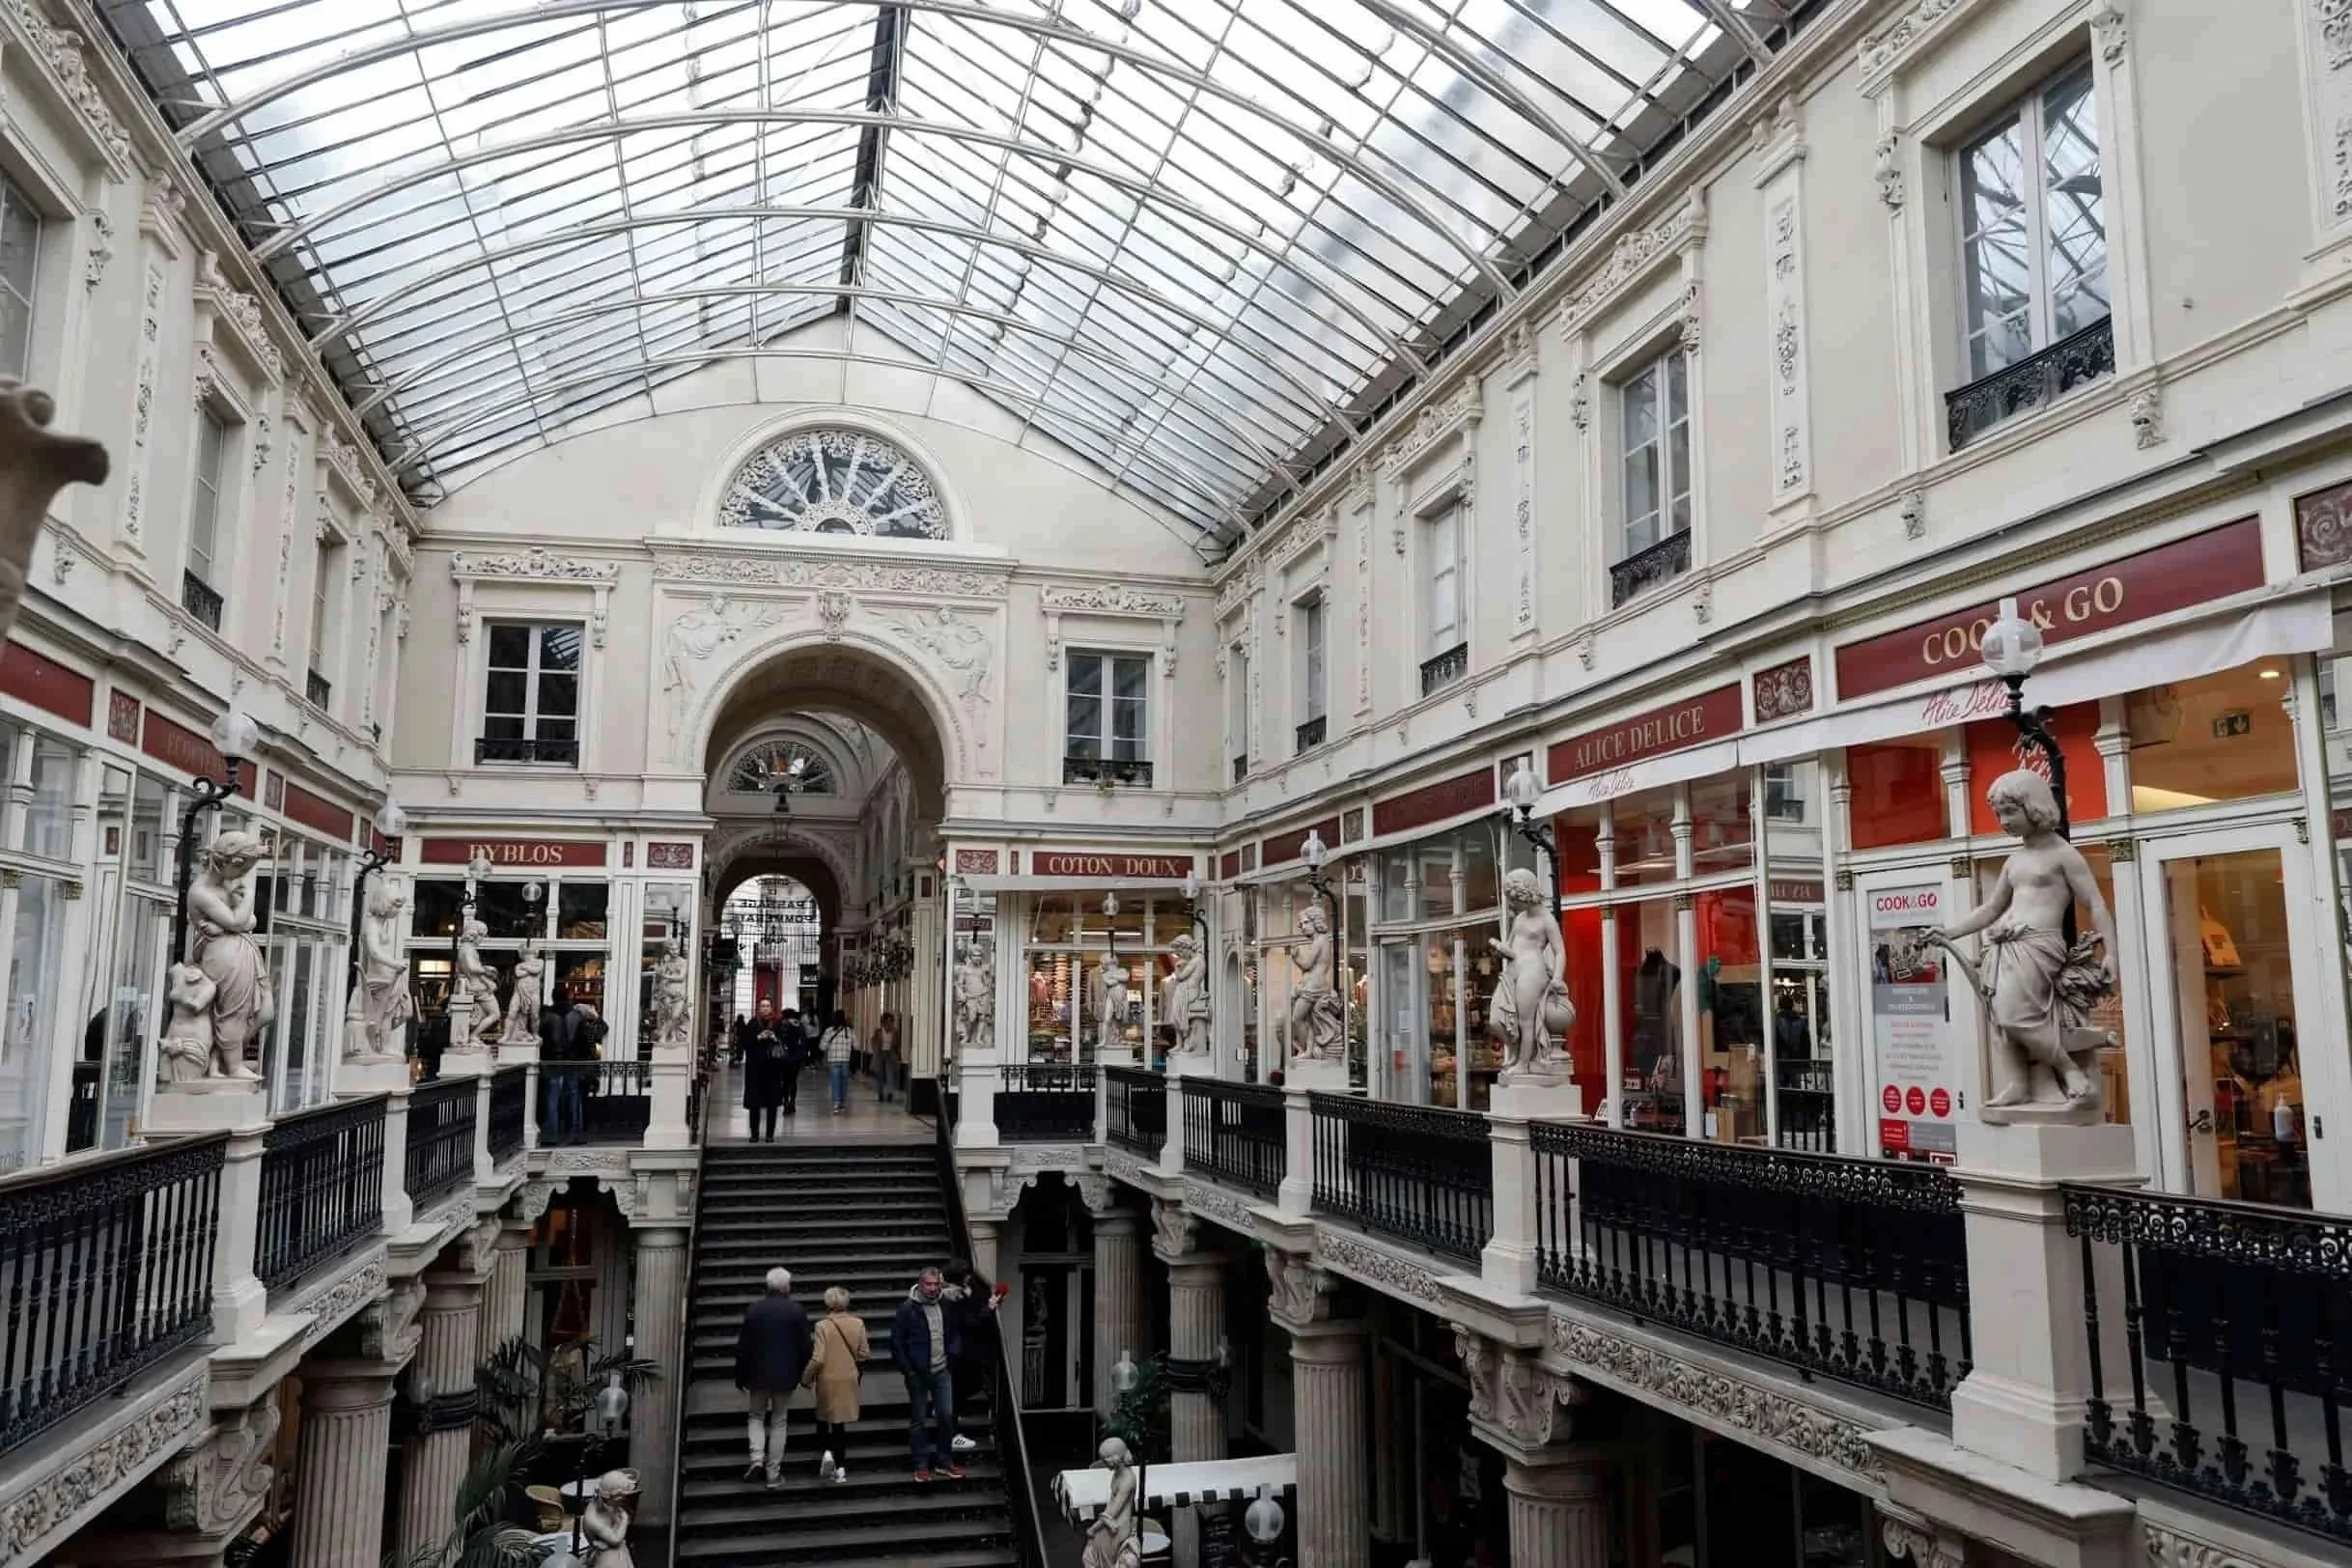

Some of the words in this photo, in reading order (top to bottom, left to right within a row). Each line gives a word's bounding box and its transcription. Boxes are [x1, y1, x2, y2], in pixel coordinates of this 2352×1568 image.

[1922, 614, 2004, 664] COO
[2031, 600, 2056, 630] &
[2064, 577, 2124, 622] GO
[1575, 731, 1626, 770] ALICE
[1630, 706, 1705, 752] DELICE
[1050, 856, 1113, 874] COTON
[1125, 857, 1182, 877] DOUX
